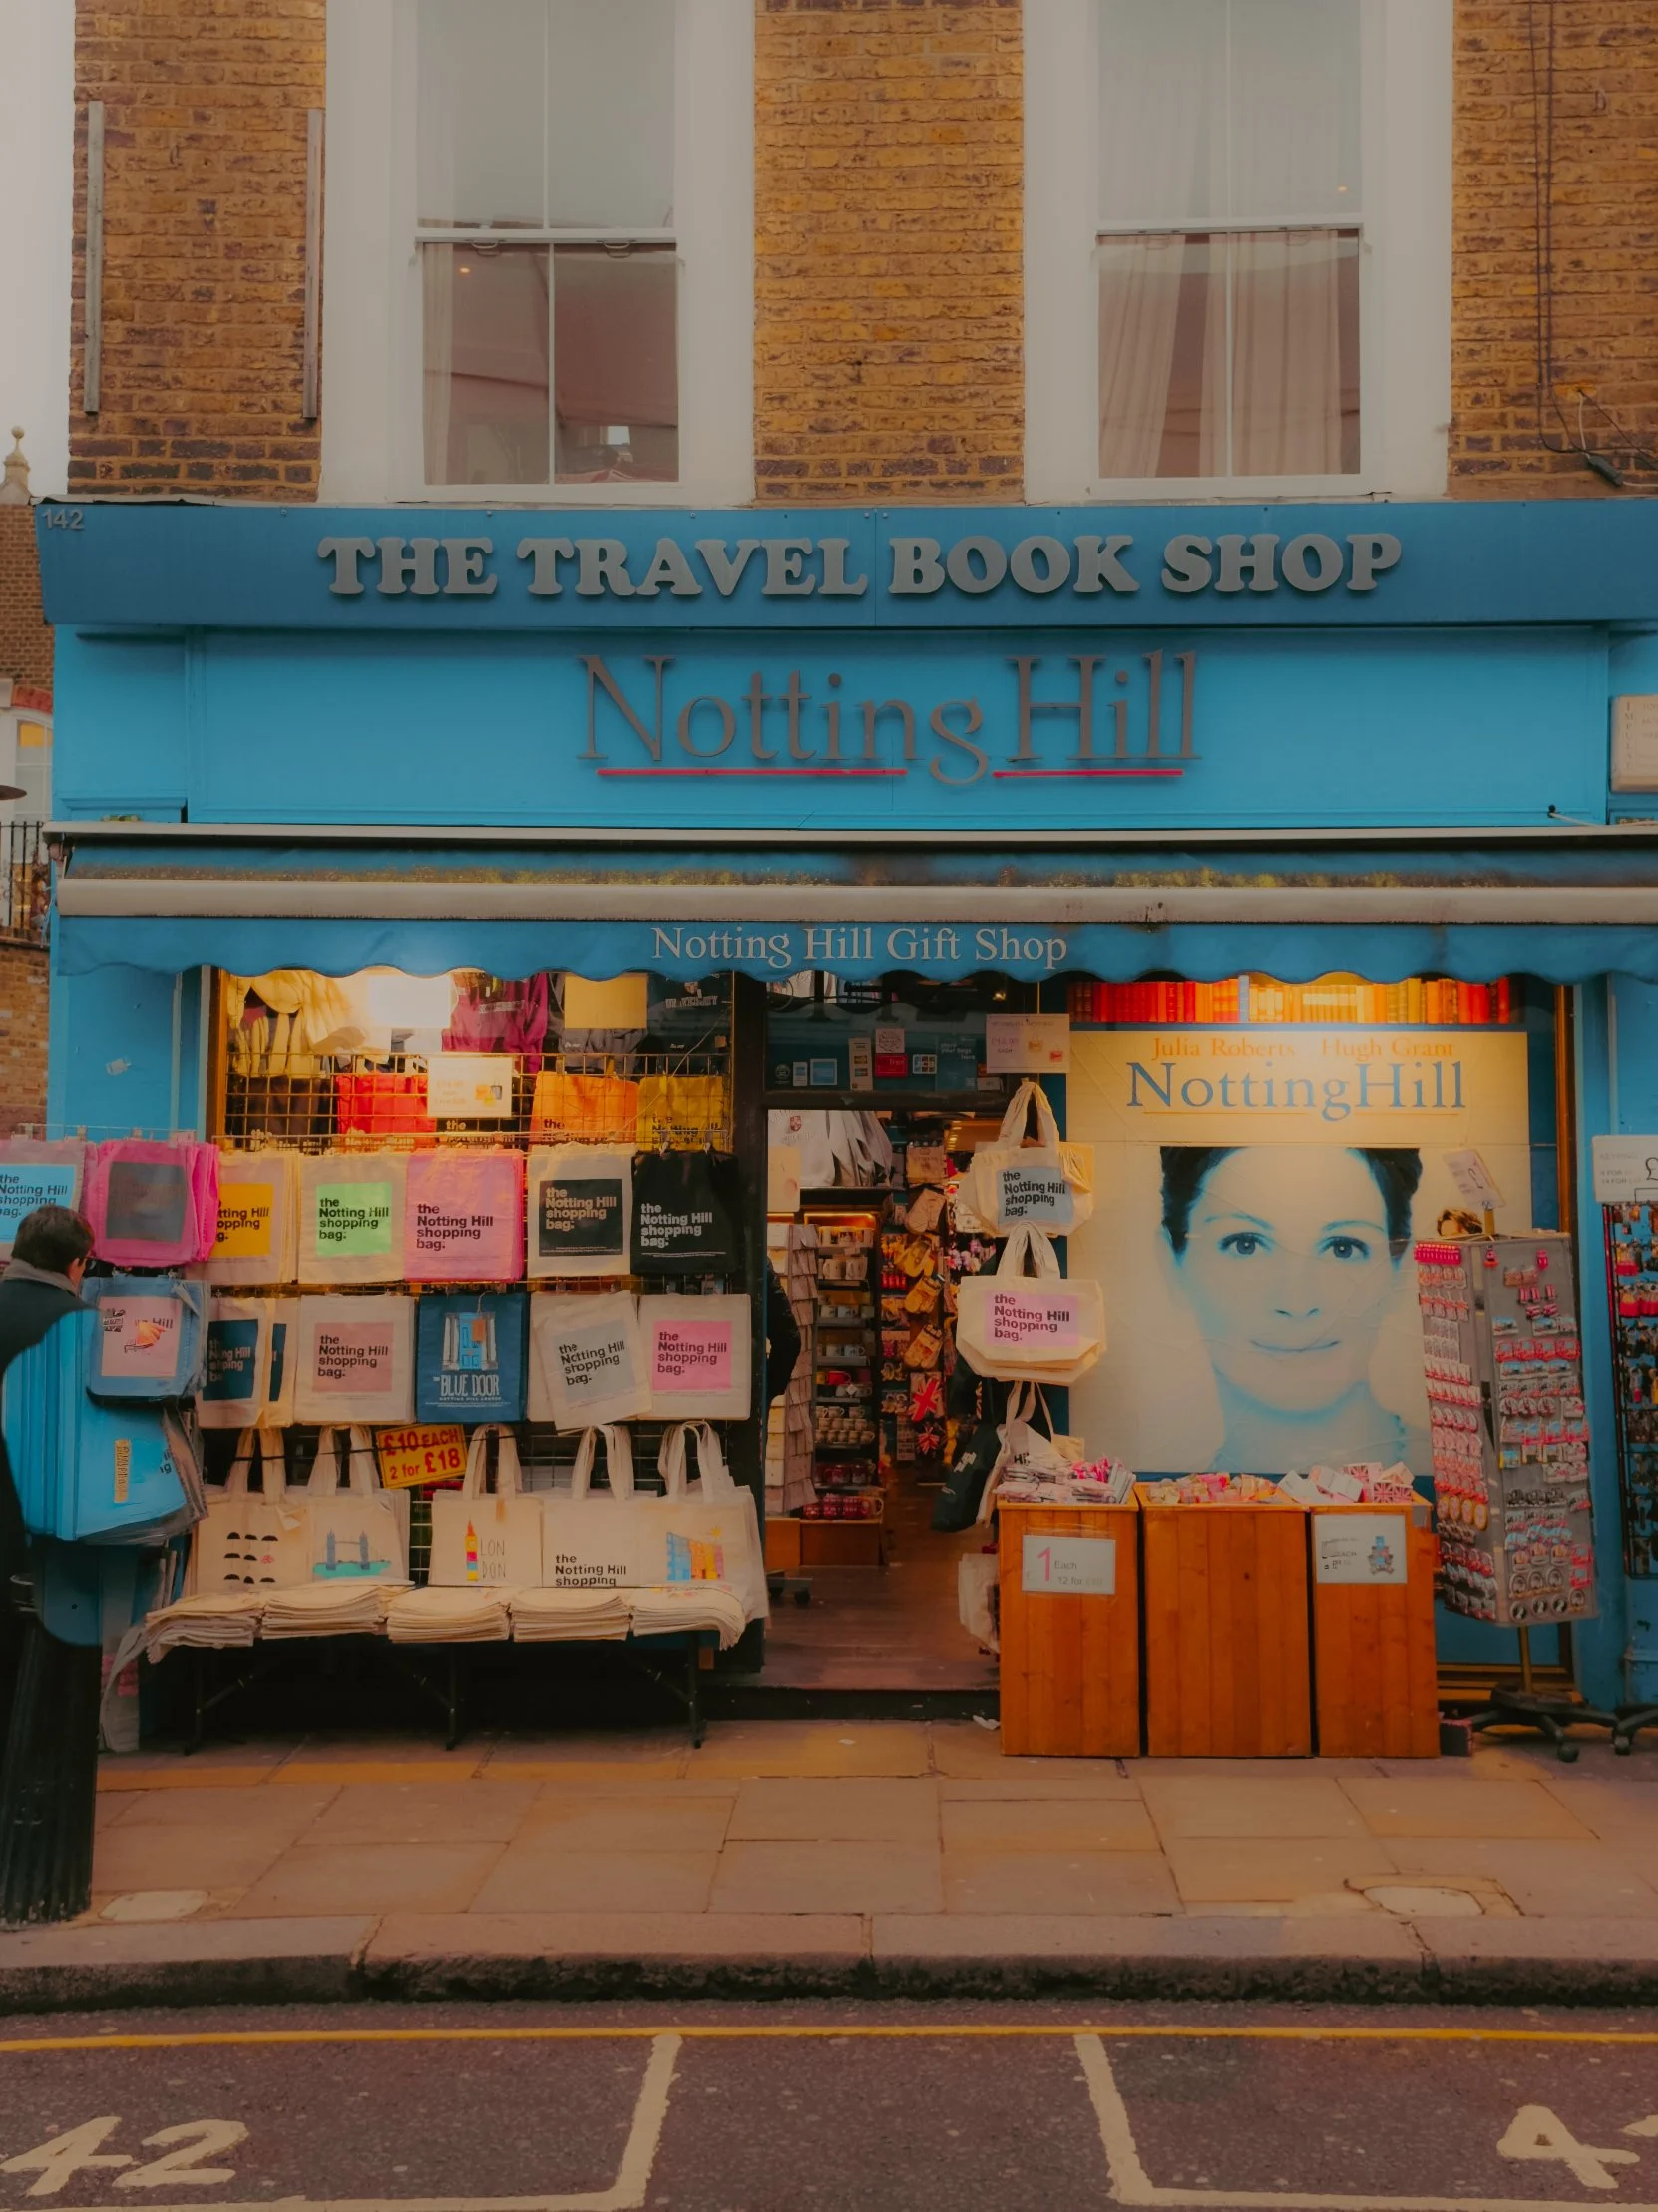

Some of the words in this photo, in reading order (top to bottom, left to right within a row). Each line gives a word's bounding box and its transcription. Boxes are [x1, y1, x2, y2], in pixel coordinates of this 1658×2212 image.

[42, 508, 85, 530] 142
[317, 536, 498, 595] THE
[516, 536, 868, 596] TRAVEL
[888, 534, 1140, 594] BOOK
[1161, 533, 1403, 594] SHOP
[650, 926, 792, 970] Notting
[802, 926, 874, 961] Hill
[886, 927, 961, 961] Gift
[975, 927, 1068, 970] Shop
[1151, 1037, 1201, 1061] Julia
[1210, 1037, 1296, 1058] Roberts
[1322, 1037, 1383, 1061] Hugh
[1391, 1037, 1454, 1058] Grant
[446, 1120, 467, 1130] the
[0, 1174, 20, 1184] the
[1003, 1170, 1021, 1182] the
[0, 1185, 43, 1196] Notting
[47, 1184, 68, 1196] Hill
[546, 1187, 568, 1198] the
[1004, 1181, 1045, 1195] Notting
[1047, 1182, 1066, 1194] Hill
[319, 1198, 340, 1208] the
[545, 1197, 594, 1210] Notting
[596, 1196, 617, 1208] Hill
[1005, 1194, 1055, 1207] shopping
[0, 1207, 21, 1218] ag.
[218, 1208, 248, 1221] tting
[251, 1207, 270, 1218] Hill
[319, 1207, 366, 1219] Notting
[369, 1207, 389, 1218] Hill
[417, 1203, 440, 1214] the
[545, 1207, 607, 1220] shopping
[640, 1203, 662, 1214] the
[216, 1219, 261, 1231] opping
[319, 1218, 379, 1230] shopping
[417, 1215, 467, 1229] Notting
[471, 1215, 494, 1227] Hill
[640, 1213, 688, 1226] Notting
[691, 1211, 713, 1224] Hill
[417, 1227, 481, 1239] shopping
[640, 1224, 702, 1238] shopping
[994, 1294, 1016, 1305] the
[994, 1305, 1043, 1323] Notting
[1047, 1310, 1070, 1322] Hill
[994, 1316, 1058, 1333] shopping
[320, 1335, 340, 1345] the
[659, 1331, 679, 1341] the
[319, 1345, 365, 1358] Notting
[368, 1345, 389, 1356] Hill
[559, 1343, 578, 1355] the
[561, 1348, 606, 1365] Notting
[608, 1340, 625, 1354] Hill
[658, 1341, 705, 1355] Notting
[707, 1342, 727, 1353] Hill
[319, 1356, 378, 1369] shopping
[564, 1355, 621, 1375] shopping
[658, 1352, 718, 1366] shopping
[441, 1374, 469, 1397] BLUE
[471, 1373, 500, 1397] DOOR
[384, 1430, 419, 1457] £10
[421, 1427, 459, 1449] EACH
[389, 1465, 398, 1480] 2
[401, 1463, 420, 1478] for
[424, 1446, 461, 1474] £18
[480, 1538, 506, 1556] LON
[555, 1553, 577, 1564] the
[1037, 1546, 1052, 1582] 1
[1054, 1559, 1077, 1571] Each
[482, 1560, 507, 1580] DON
[555, 1564, 604, 1576] Notting
[607, 1564, 627, 1576] Hill
[555, 1575, 617, 1588] shopping
[1070, 1576, 1082, 1586] for
[1496, 2104, 1658, 2189] 4
[0, 2116, 249, 2197] 42
